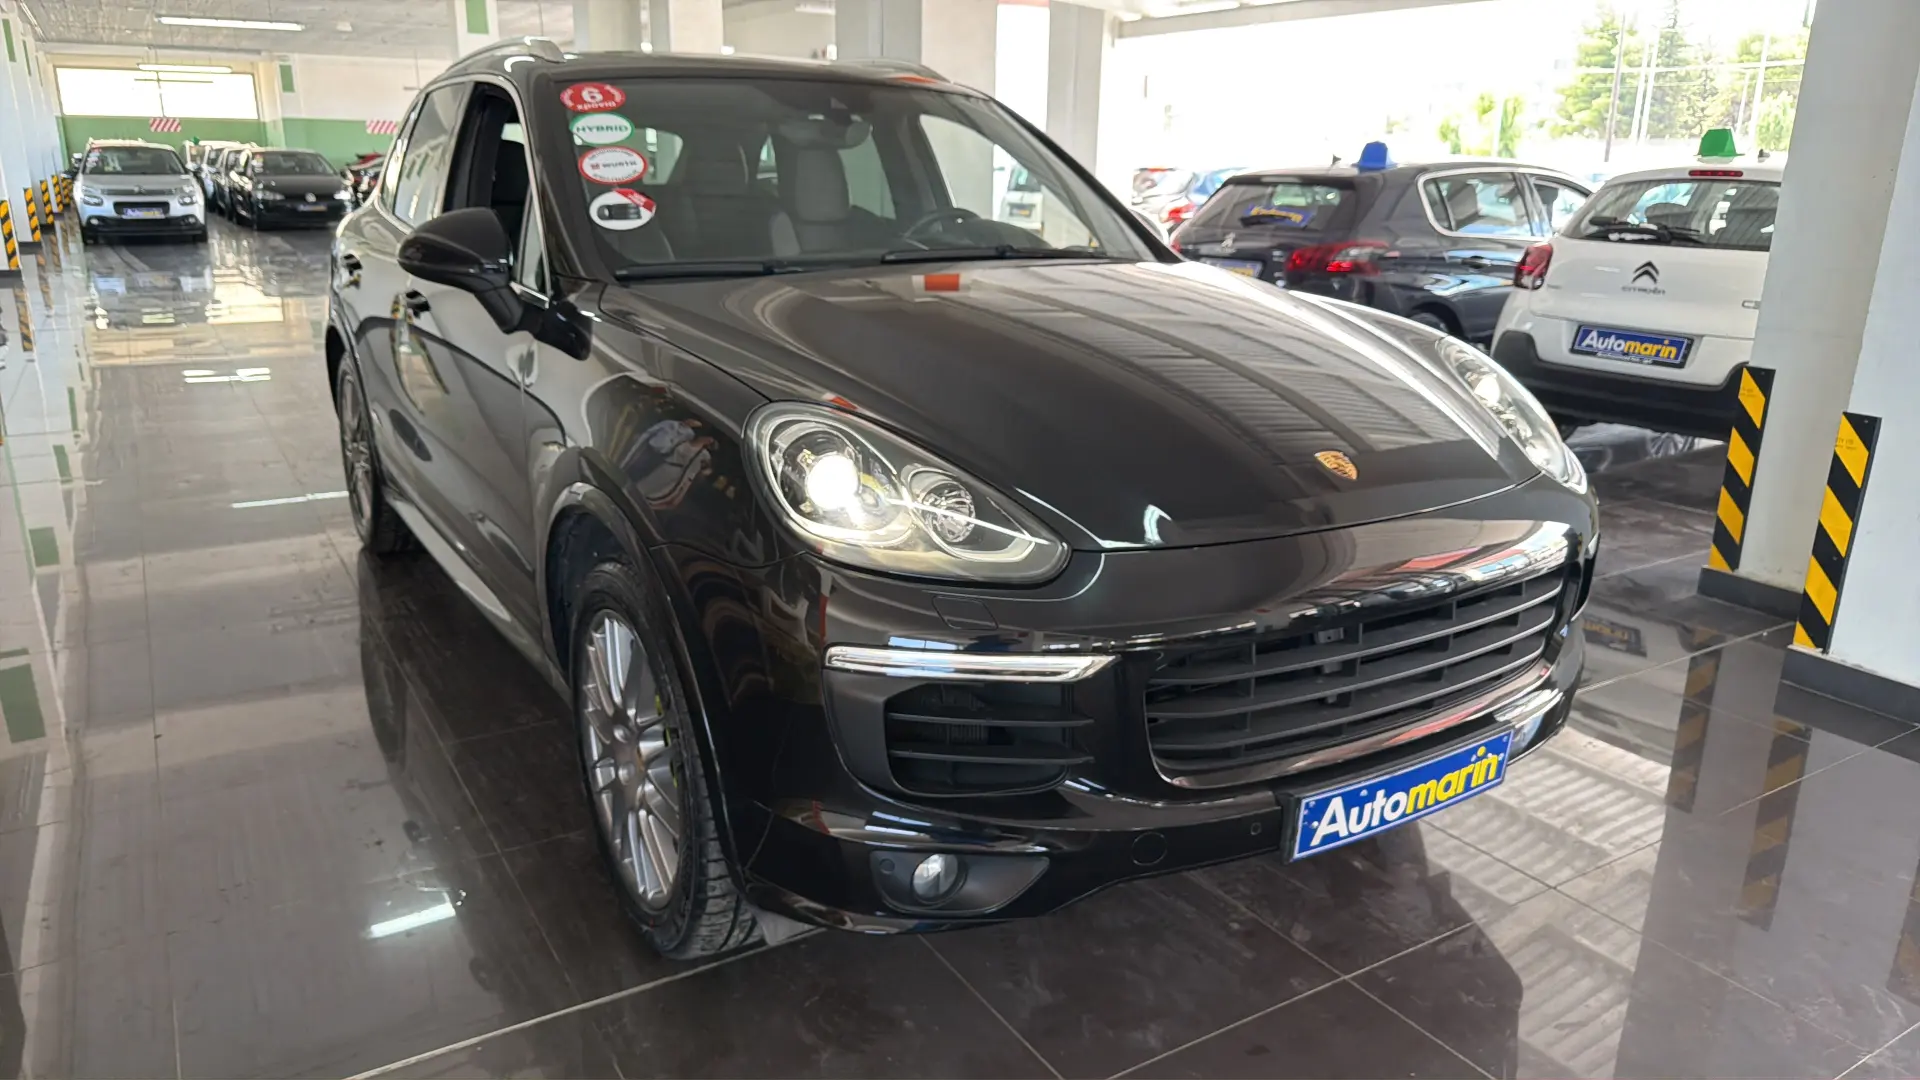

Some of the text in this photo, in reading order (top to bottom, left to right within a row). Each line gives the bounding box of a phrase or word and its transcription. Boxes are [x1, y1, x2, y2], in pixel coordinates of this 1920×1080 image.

[581, 86, 603, 103] 6
[1581, 330, 1678, 360] Automarin
[1310, 746, 1499, 847] Automarin
